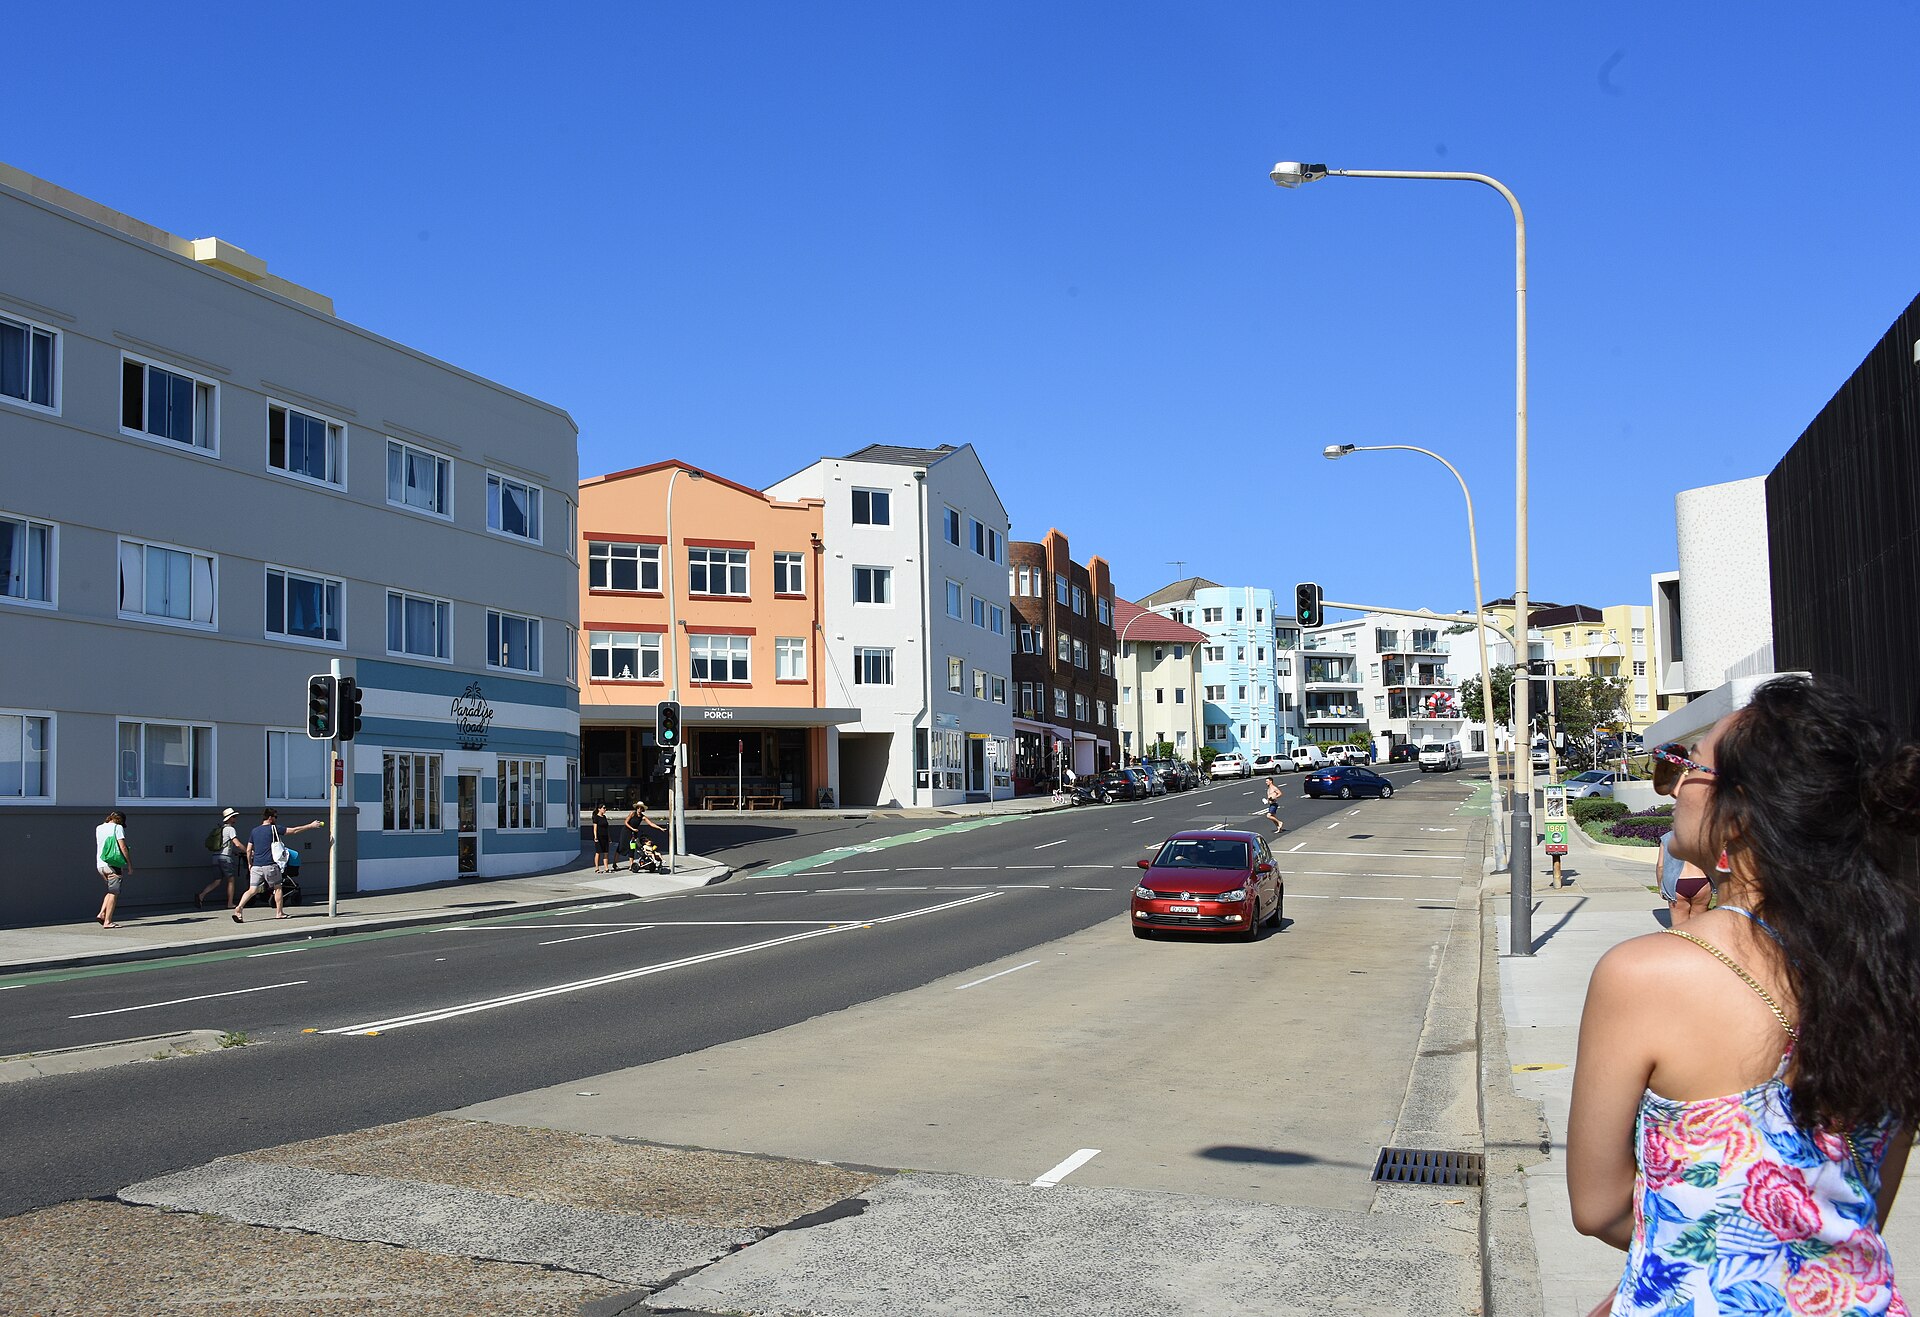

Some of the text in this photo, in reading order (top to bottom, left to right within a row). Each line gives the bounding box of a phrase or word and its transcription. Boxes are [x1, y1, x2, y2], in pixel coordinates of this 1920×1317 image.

[451, 698, 493, 719] Paradise
[704, 711, 733, 719] PORCH
[460, 717, 485, 734] Road
